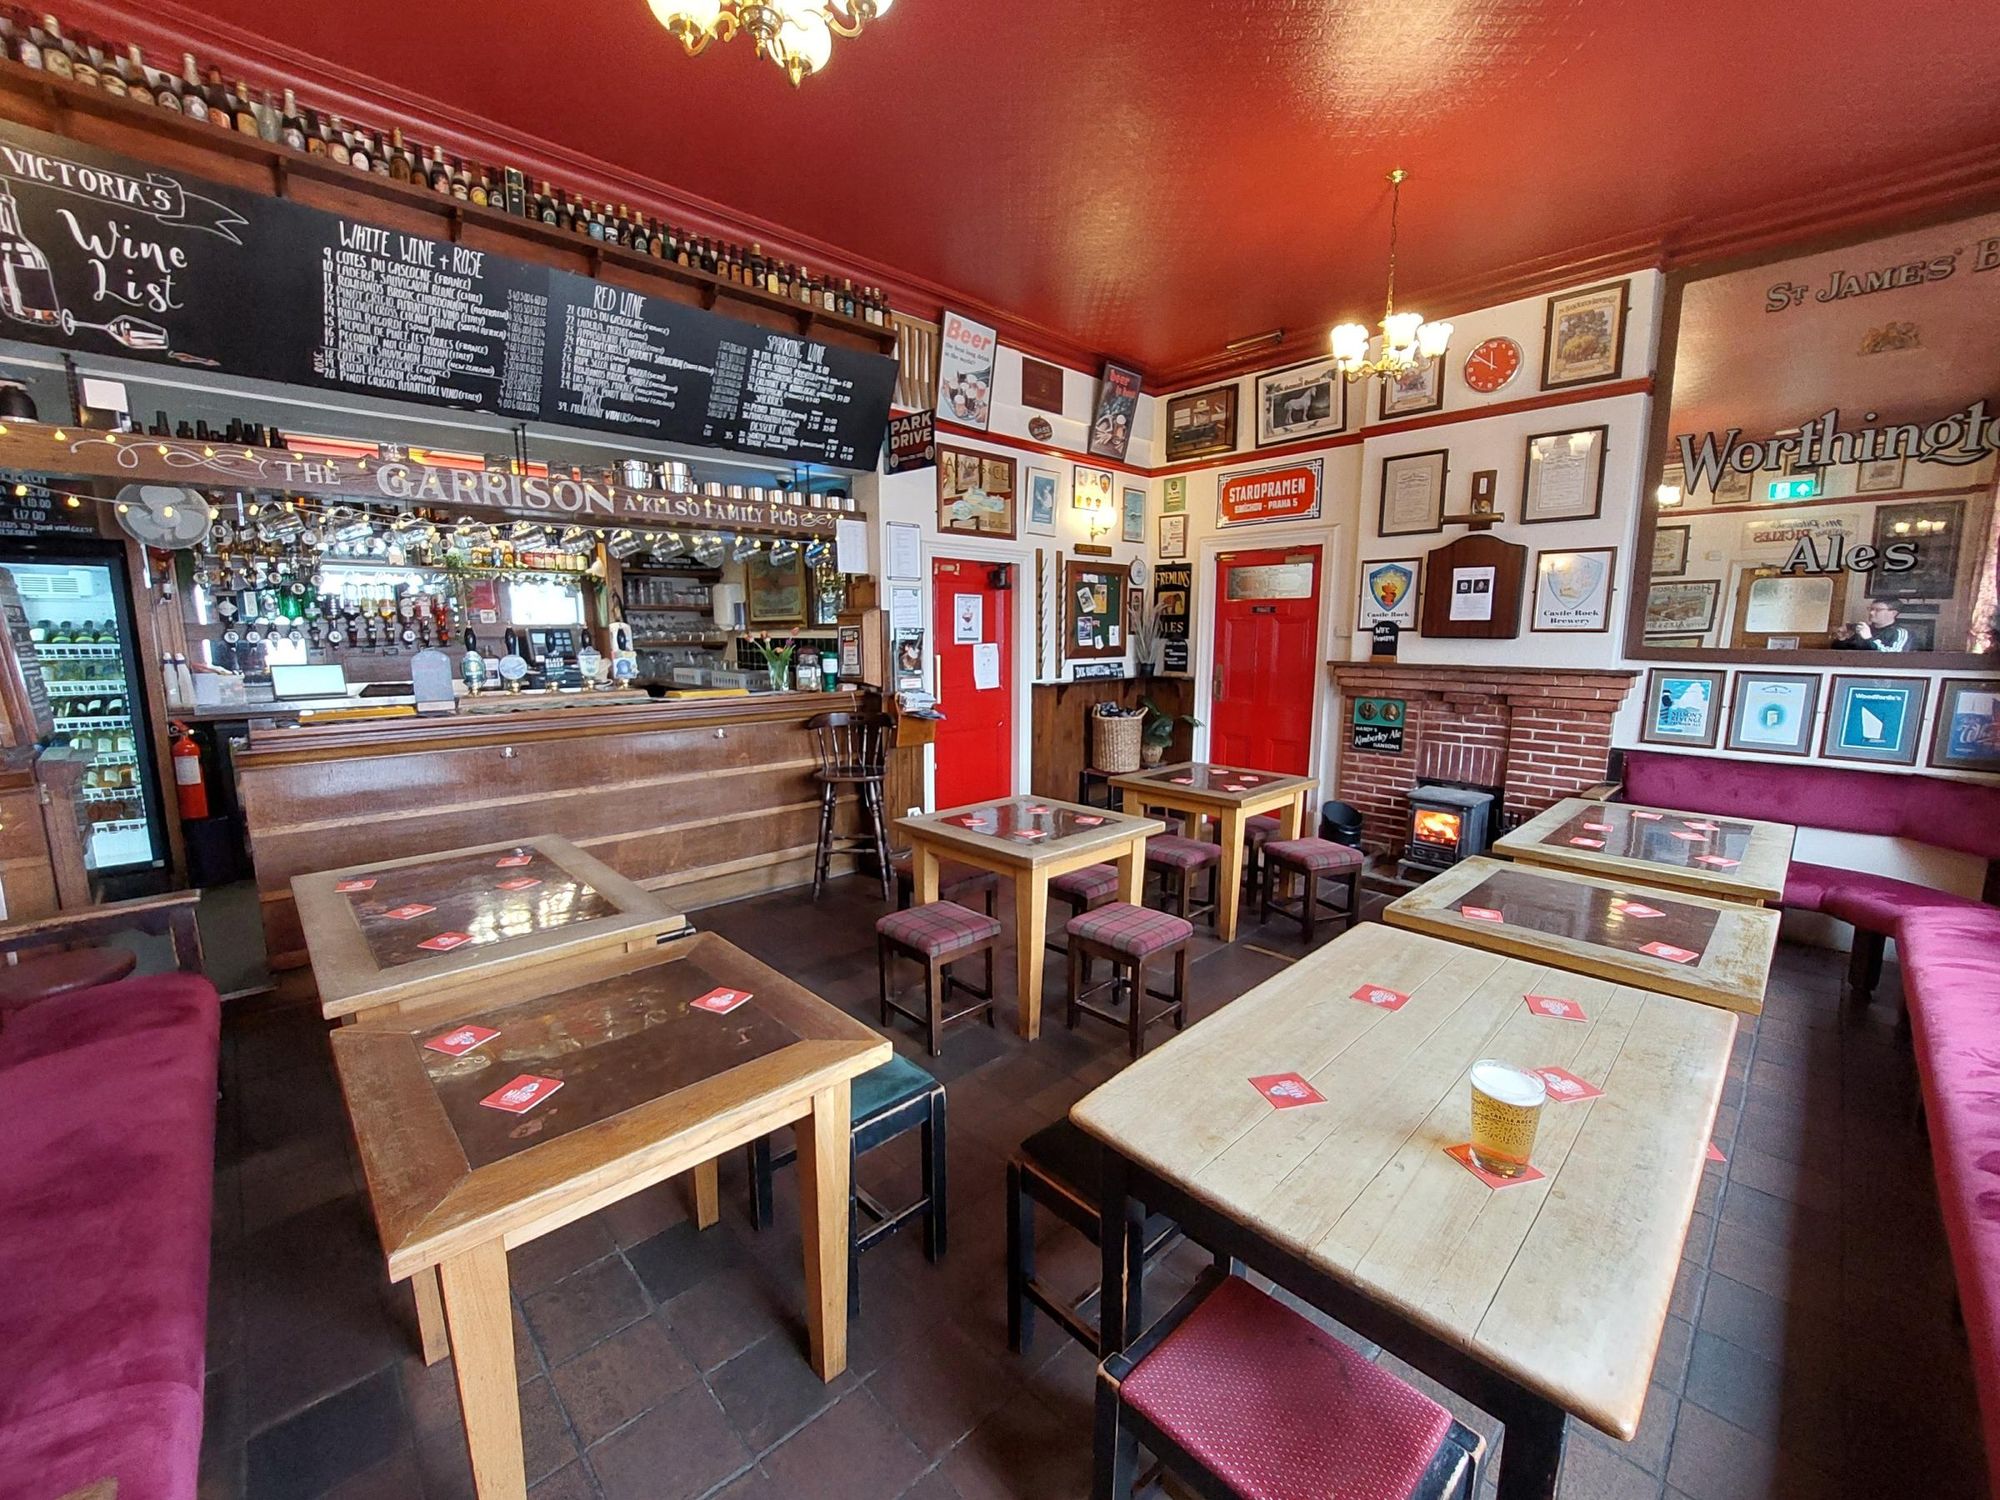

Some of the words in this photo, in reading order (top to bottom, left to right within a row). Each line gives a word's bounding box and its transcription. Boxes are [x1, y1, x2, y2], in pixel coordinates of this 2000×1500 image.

[1, 147, 172, 211] VICTORIA'S
[56, 209, 188, 274] Wine
[339, 220, 391, 257] WHITE
[452, 247, 485, 279] ROSE
[371, 257, 385, 272] DU
[88, 258, 184, 312] List
[594, 284, 617, 312] RED
[947, 318, 992, 350] Beer
[891, 411, 931, 435] PARK
[891, 427, 932, 449] DRIVE
[275, 460, 341, 485] THE
[376, 463, 614, 514] GARRISON
[624, 497, 638, 512] A
[641, 498, 699, 517] KELSO
[706, 501, 763, 523] FAMILY
[769, 511, 797, 527] PUB
[1229, 478, 1306, 503] STAROPRAMEN
[1292, 498, 1298, 507] 5
[1780, 535, 1919, 574] Ales
[1155, 571, 1190, 588] FREMLINS
[1550, 617, 1589, 625] Brewery
